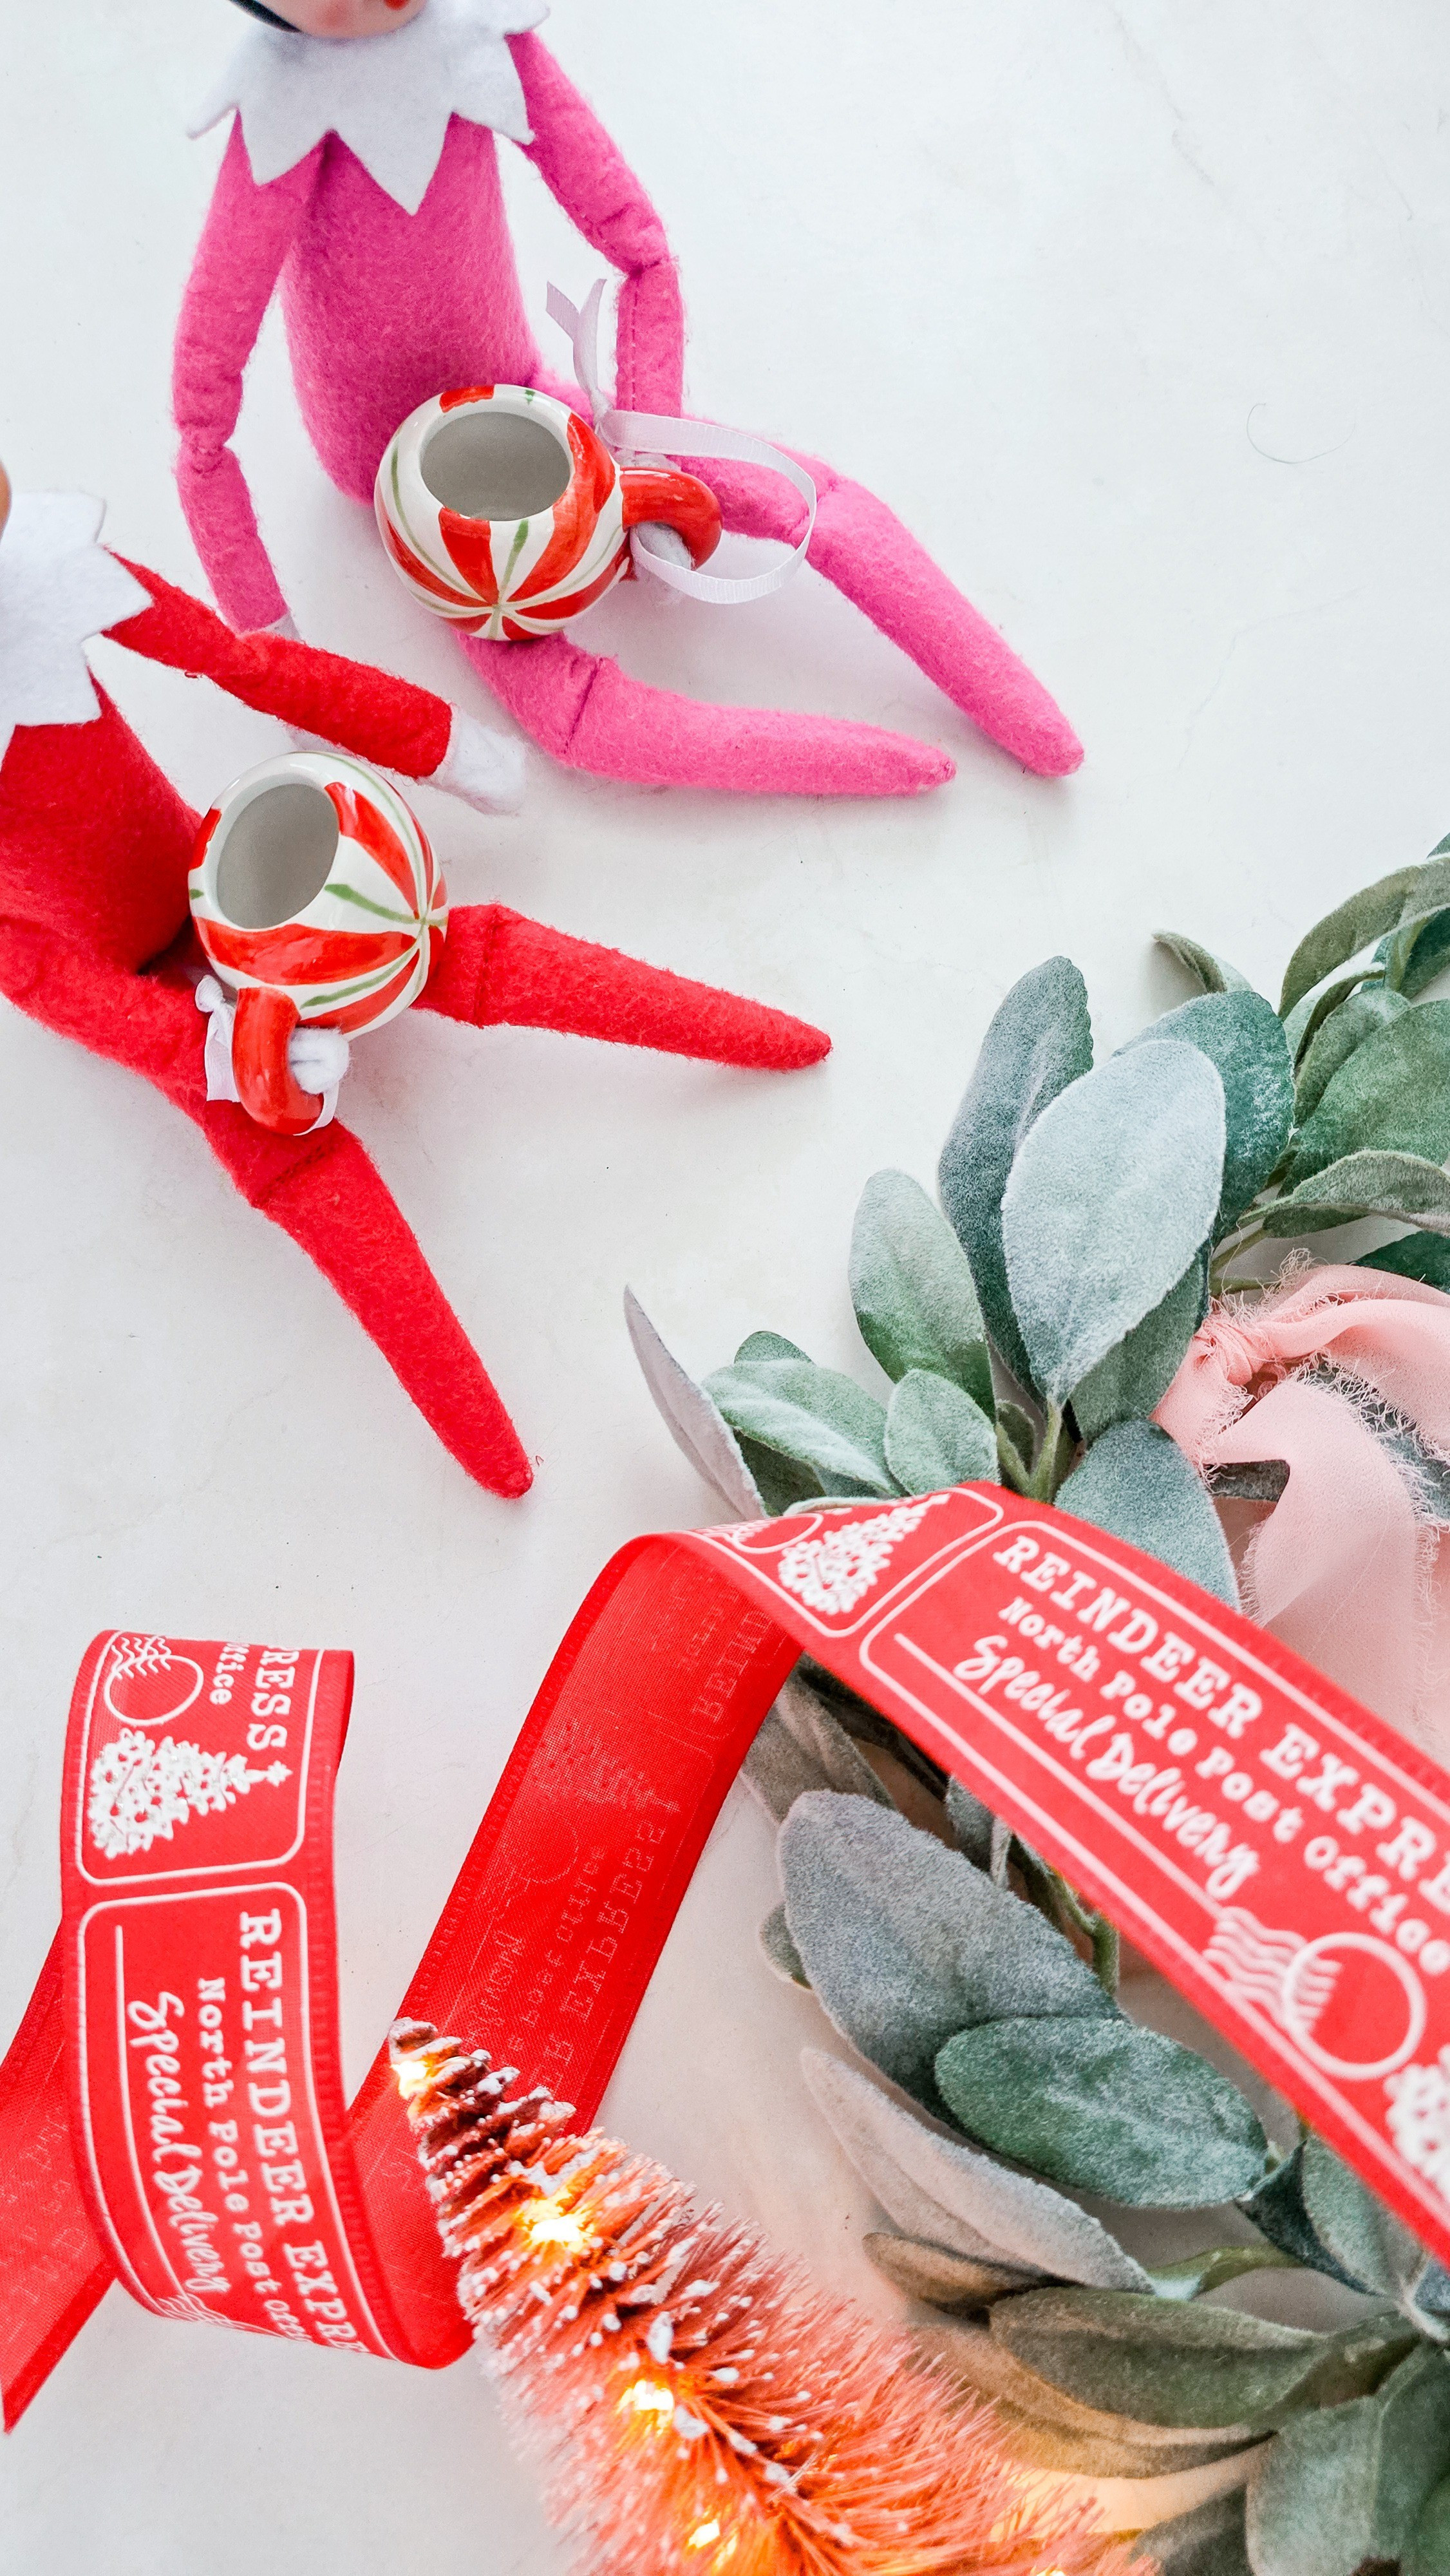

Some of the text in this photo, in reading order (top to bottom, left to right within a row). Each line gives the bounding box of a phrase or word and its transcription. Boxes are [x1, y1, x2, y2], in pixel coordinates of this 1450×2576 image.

[209, 1643, 250, 1705] ffice
[247, 1645, 301, 1750] RESS
[993, 1535, 1263, 1738] REINDEER
[999, 1596, 1101, 1682] North
[1100, 1671, 1198, 1755] Pole
[1196, 1747, 1303, 1842] Post
[953, 1635, 1260, 1900] Special Delivery
[198, 1977, 232, 2108] North
[240, 1908, 314, 2226] REINDEER
[128, 1991, 231, 2293] Special Delivery
[209, 2120, 249, 2211] Pole
[232, 2221, 281, 2293] Post
